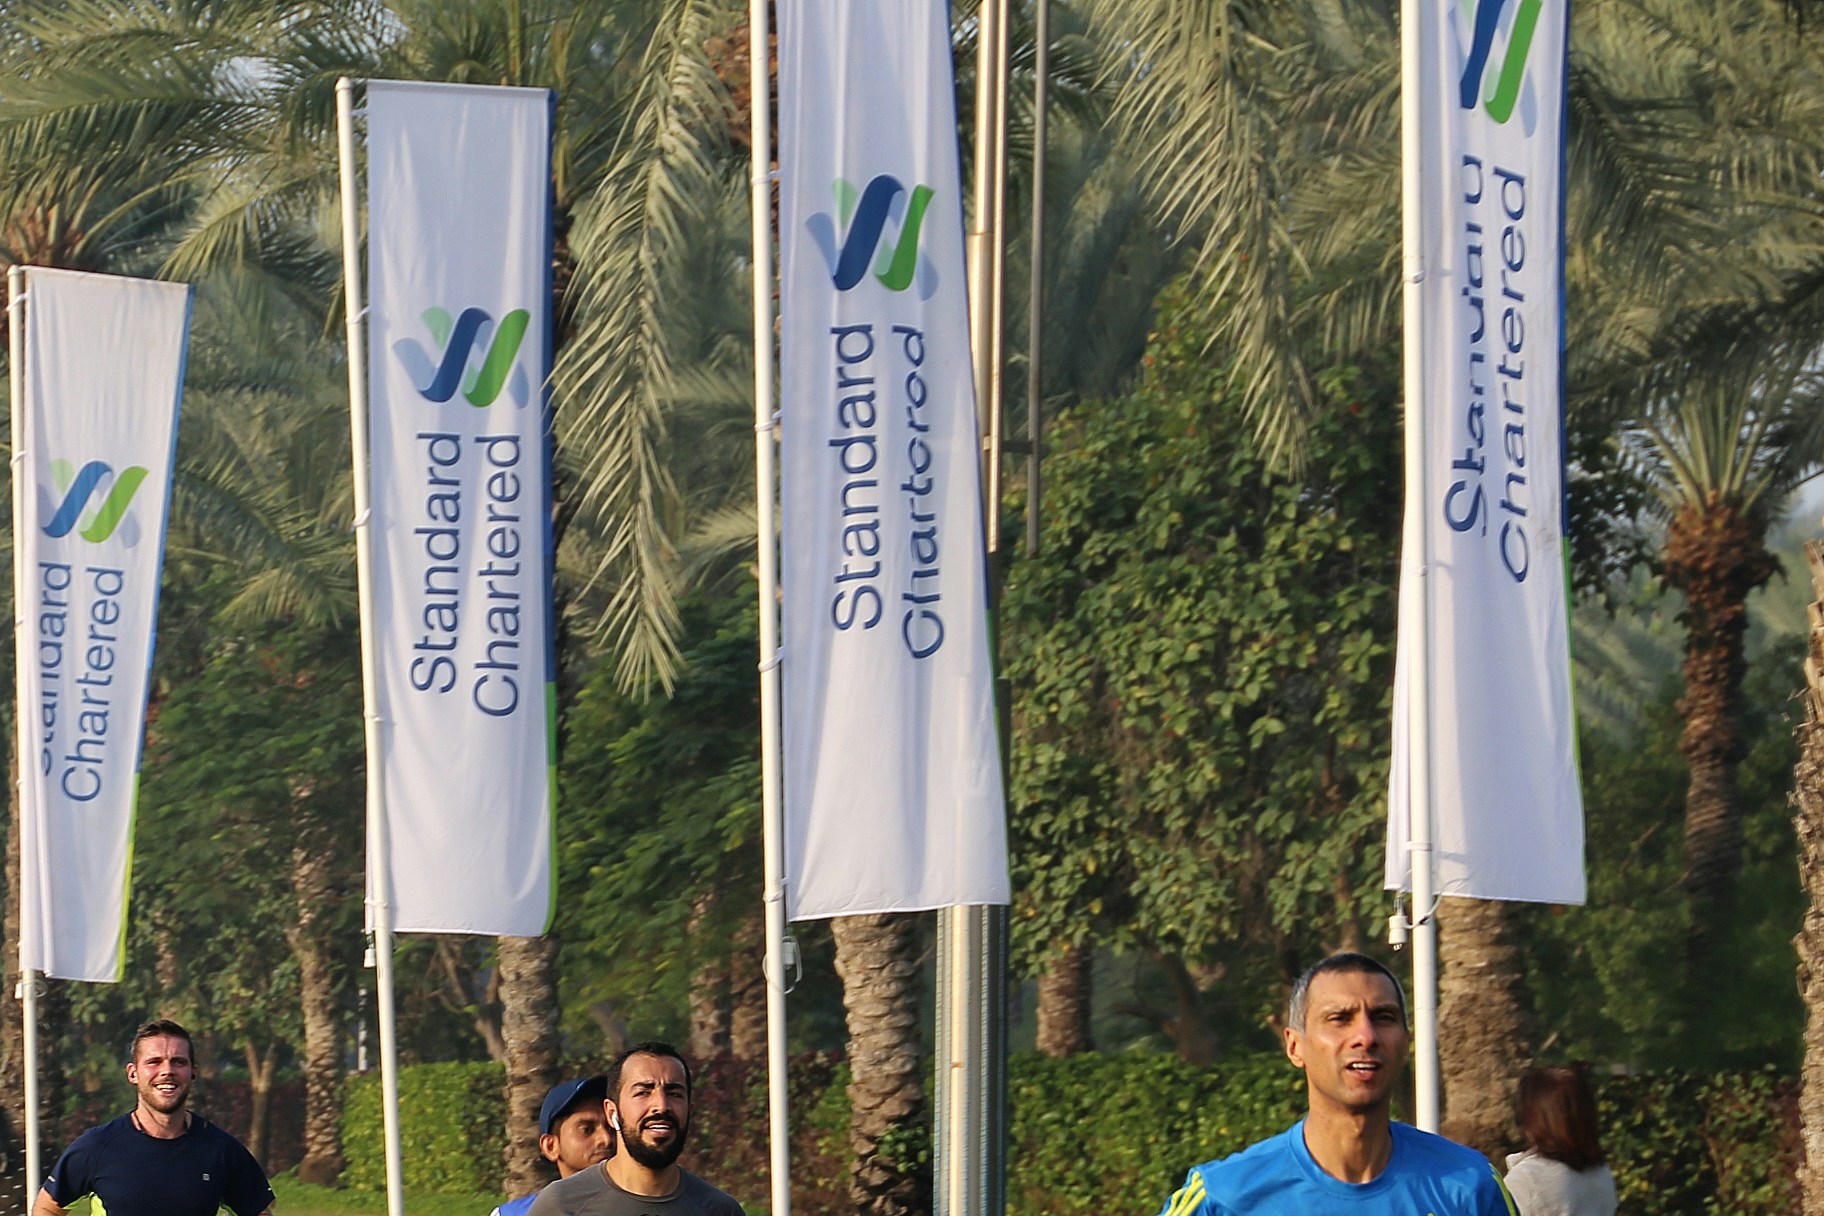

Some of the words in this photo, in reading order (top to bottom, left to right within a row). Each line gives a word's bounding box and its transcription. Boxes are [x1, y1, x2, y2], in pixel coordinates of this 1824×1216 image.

[828, 323, 882, 632] Standard
[891, 323, 944, 661] Chartered
[1493, 165, 1529, 584] Chartered
[61, 566, 124, 802] Chartered
[409, 432, 461, 694] Standard
[472, 434, 520, 717] Chartered
